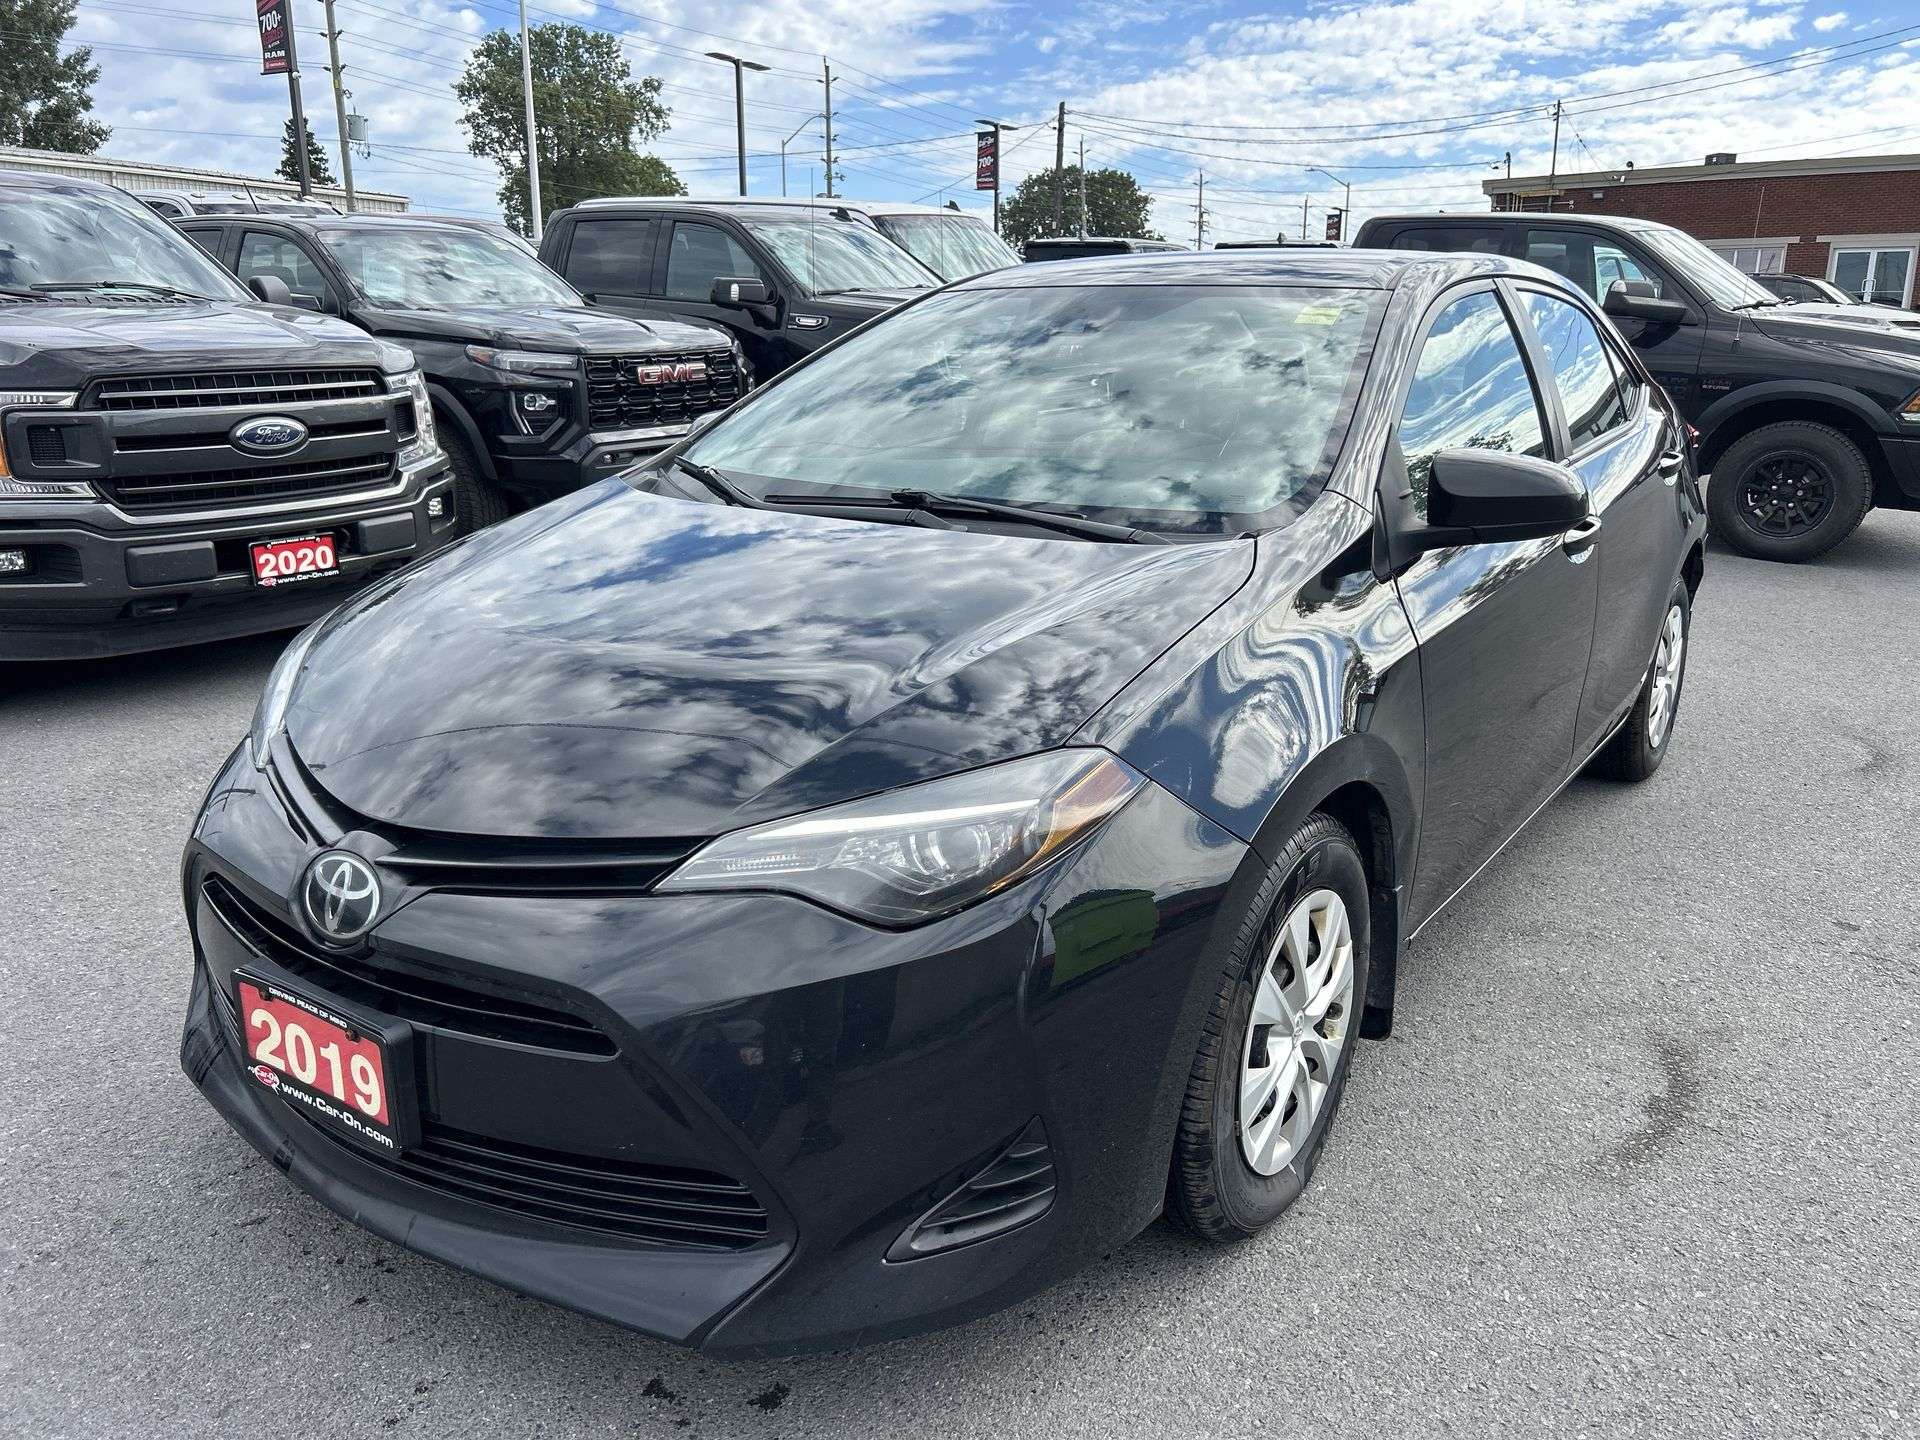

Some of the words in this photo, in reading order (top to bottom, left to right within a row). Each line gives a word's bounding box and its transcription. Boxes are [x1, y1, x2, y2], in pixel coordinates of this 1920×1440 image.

[259, 10, 282, 34] 700+
[264, 50, 286, 59] RAM
[637, 362, 707, 385] GMC
[255, 426, 291, 443] Ford
[258, 545, 334, 579] 2020
[277, 569, 340, 585] www.Car-On.com
[268, 986, 296, 1004] DRIVING
[296, 999, 319, 1015] PEACE
[319, 1009, 329, 1019] OF
[329, 1014, 348, 1029] MIND
[250, 1007, 382, 1118] 2019
[281, 1081, 394, 1149] www.Car-On.com
